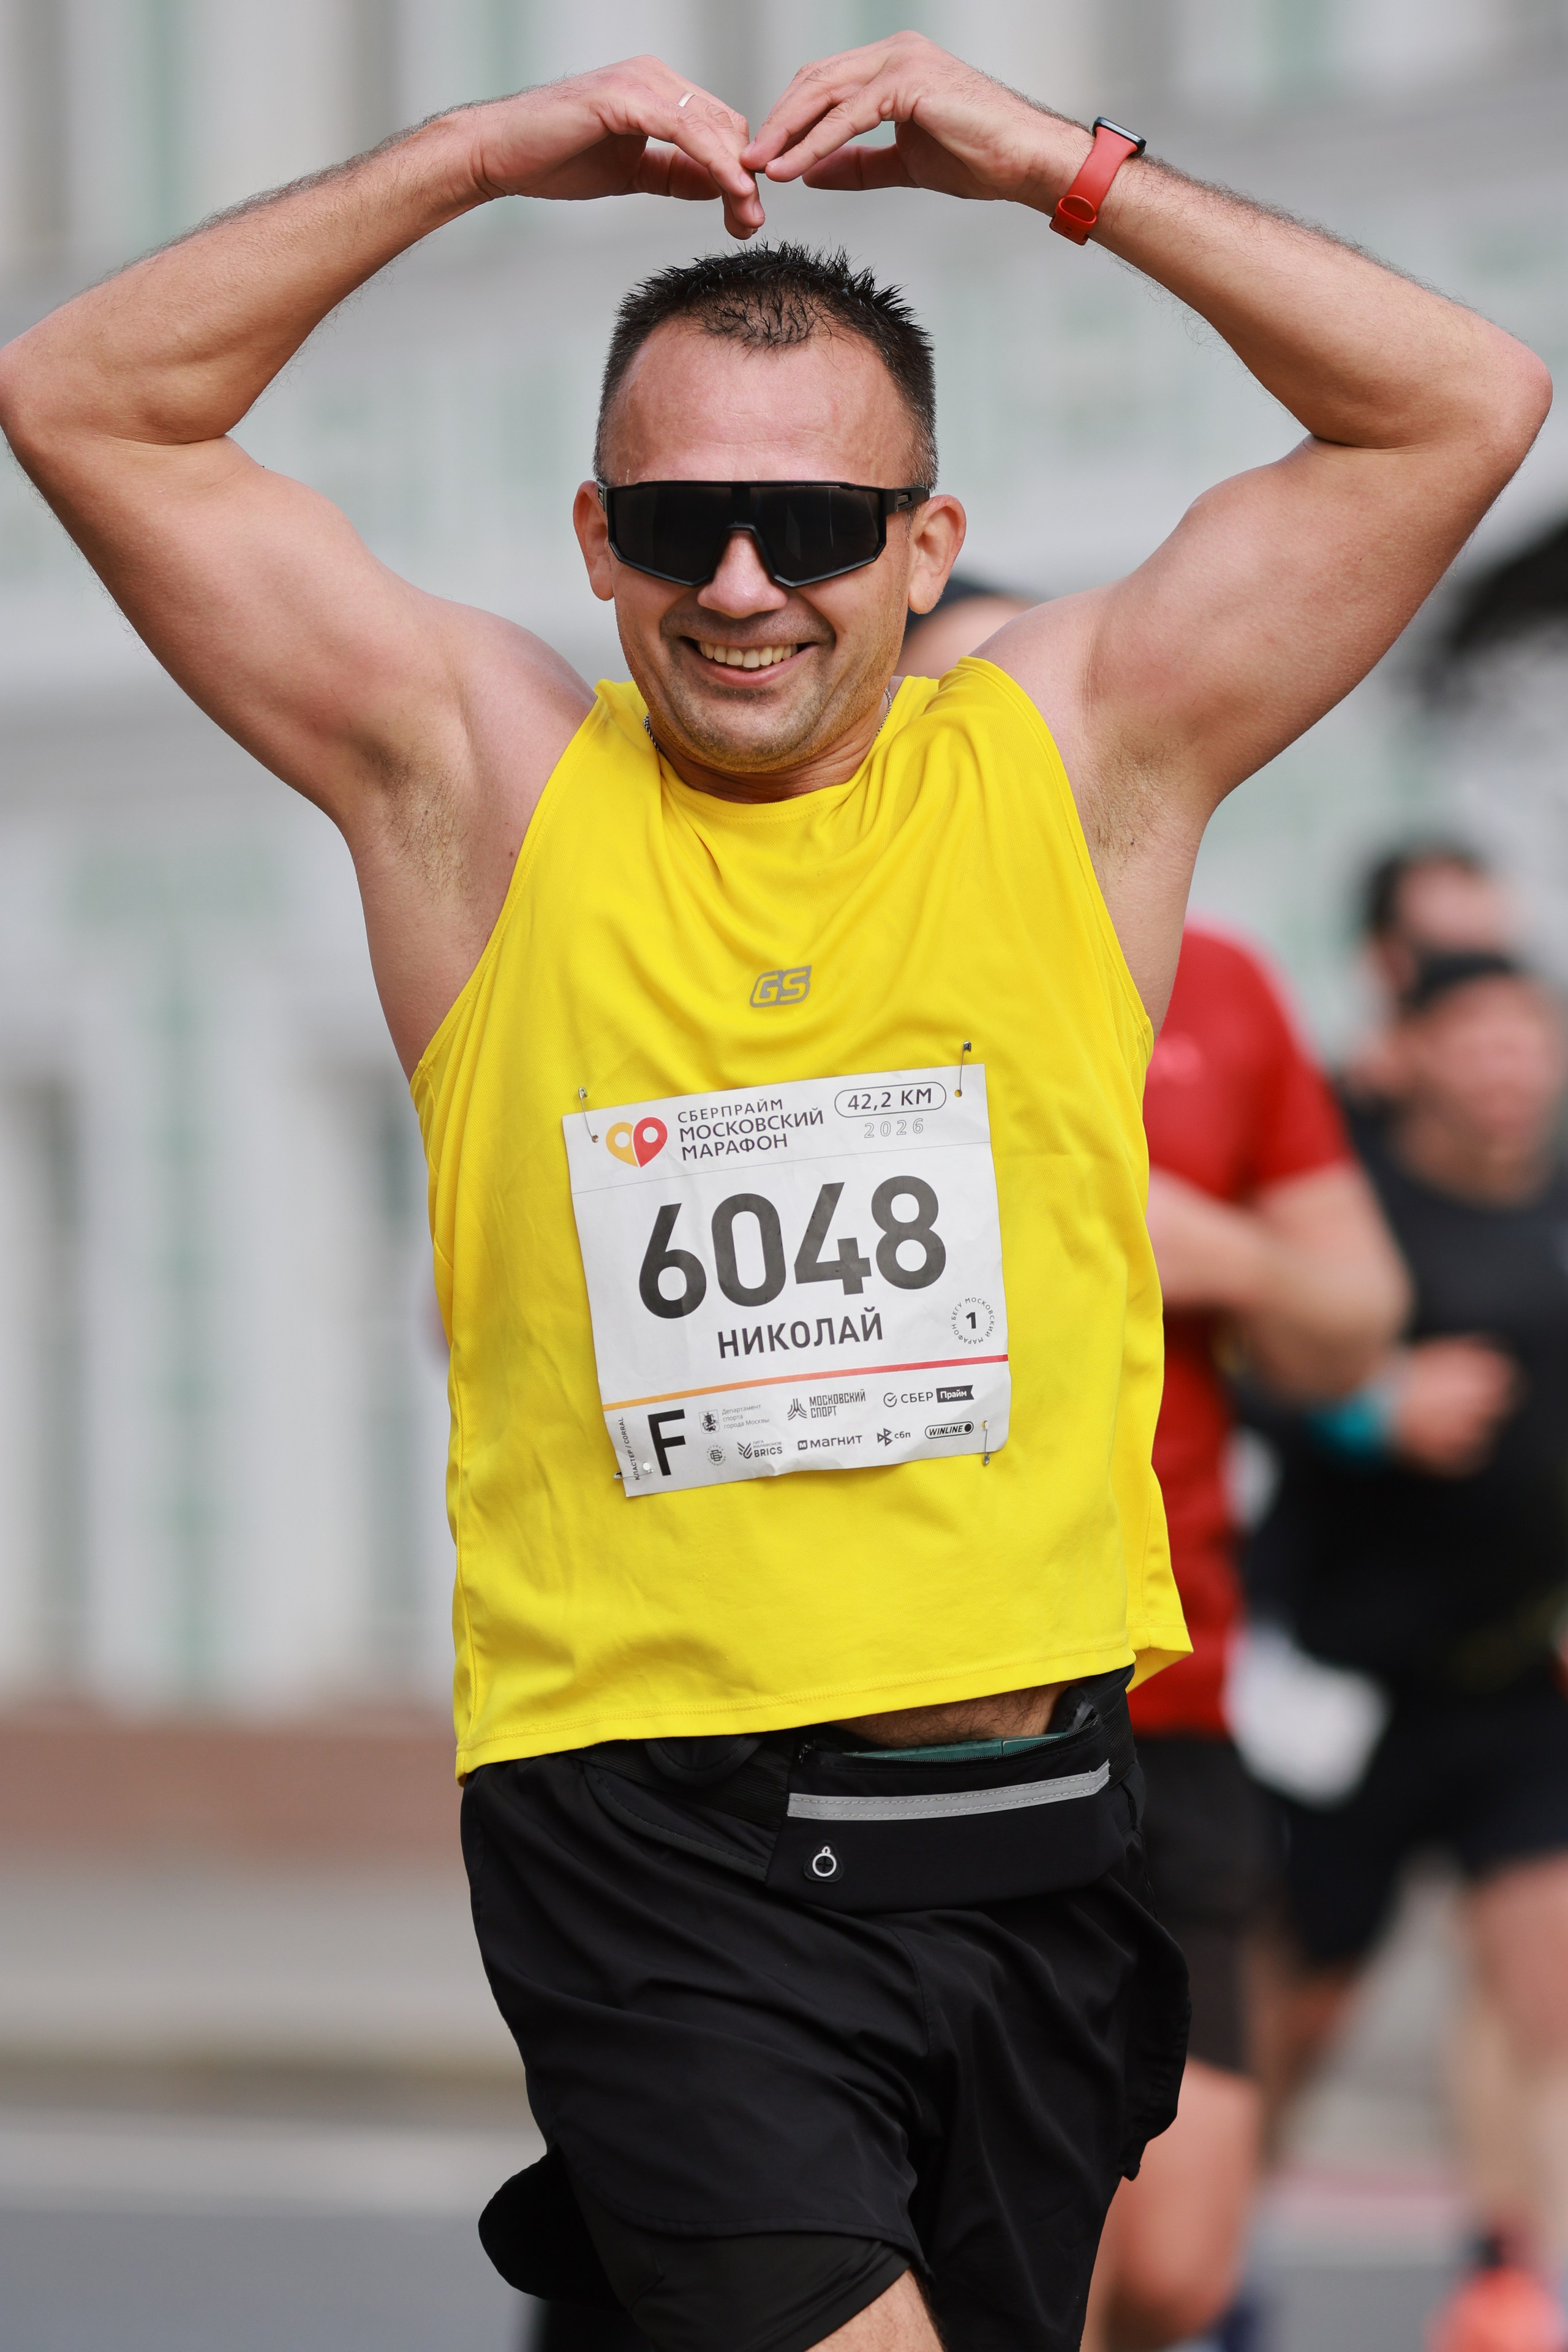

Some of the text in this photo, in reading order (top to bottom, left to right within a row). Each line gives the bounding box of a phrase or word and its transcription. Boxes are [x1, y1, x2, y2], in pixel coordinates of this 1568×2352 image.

[750, 965, 812, 1008] GS
[677, 1098, 783, 1123] СБЕРПРАЙМ
[847, 1088, 932, 1111] 42,2 КМ
[679, 1107, 824, 1142] МОСКОВСКИЙ
[864, 1118, 924, 1139] 2026
[681, 1133, 788, 1161] МАРАФОН
[639, 1175, 946, 1319] 6048
[951, 1297, 995, 1344] БЕГУ МОСКОВСКИЙ МАРАФОН
[965, 1311, 976, 1329] 1
[717, 1306, 883, 1359] НИКОЛАЙ
[809, 1389, 866, 1407] МОСКОВСКИЙ
[900, 1389, 968, 1403] СБЕР Прайм
[722, 1404, 761, 1415] Департамент
[810, 1406, 837, 1419] СПОРТ
[618, 1417, 630, 1444] CORRAL
[647, 1408, 687, 1476] F
[810, 1435, 863, 1449] магнит
[894, 1431, 911, 1439] сбп
[929, 1425, 963, 1436] WINLINE
[753, 1446, 783, 1457] BRICS
[627, 1449, 640, 1480] КЛАСТЕР
